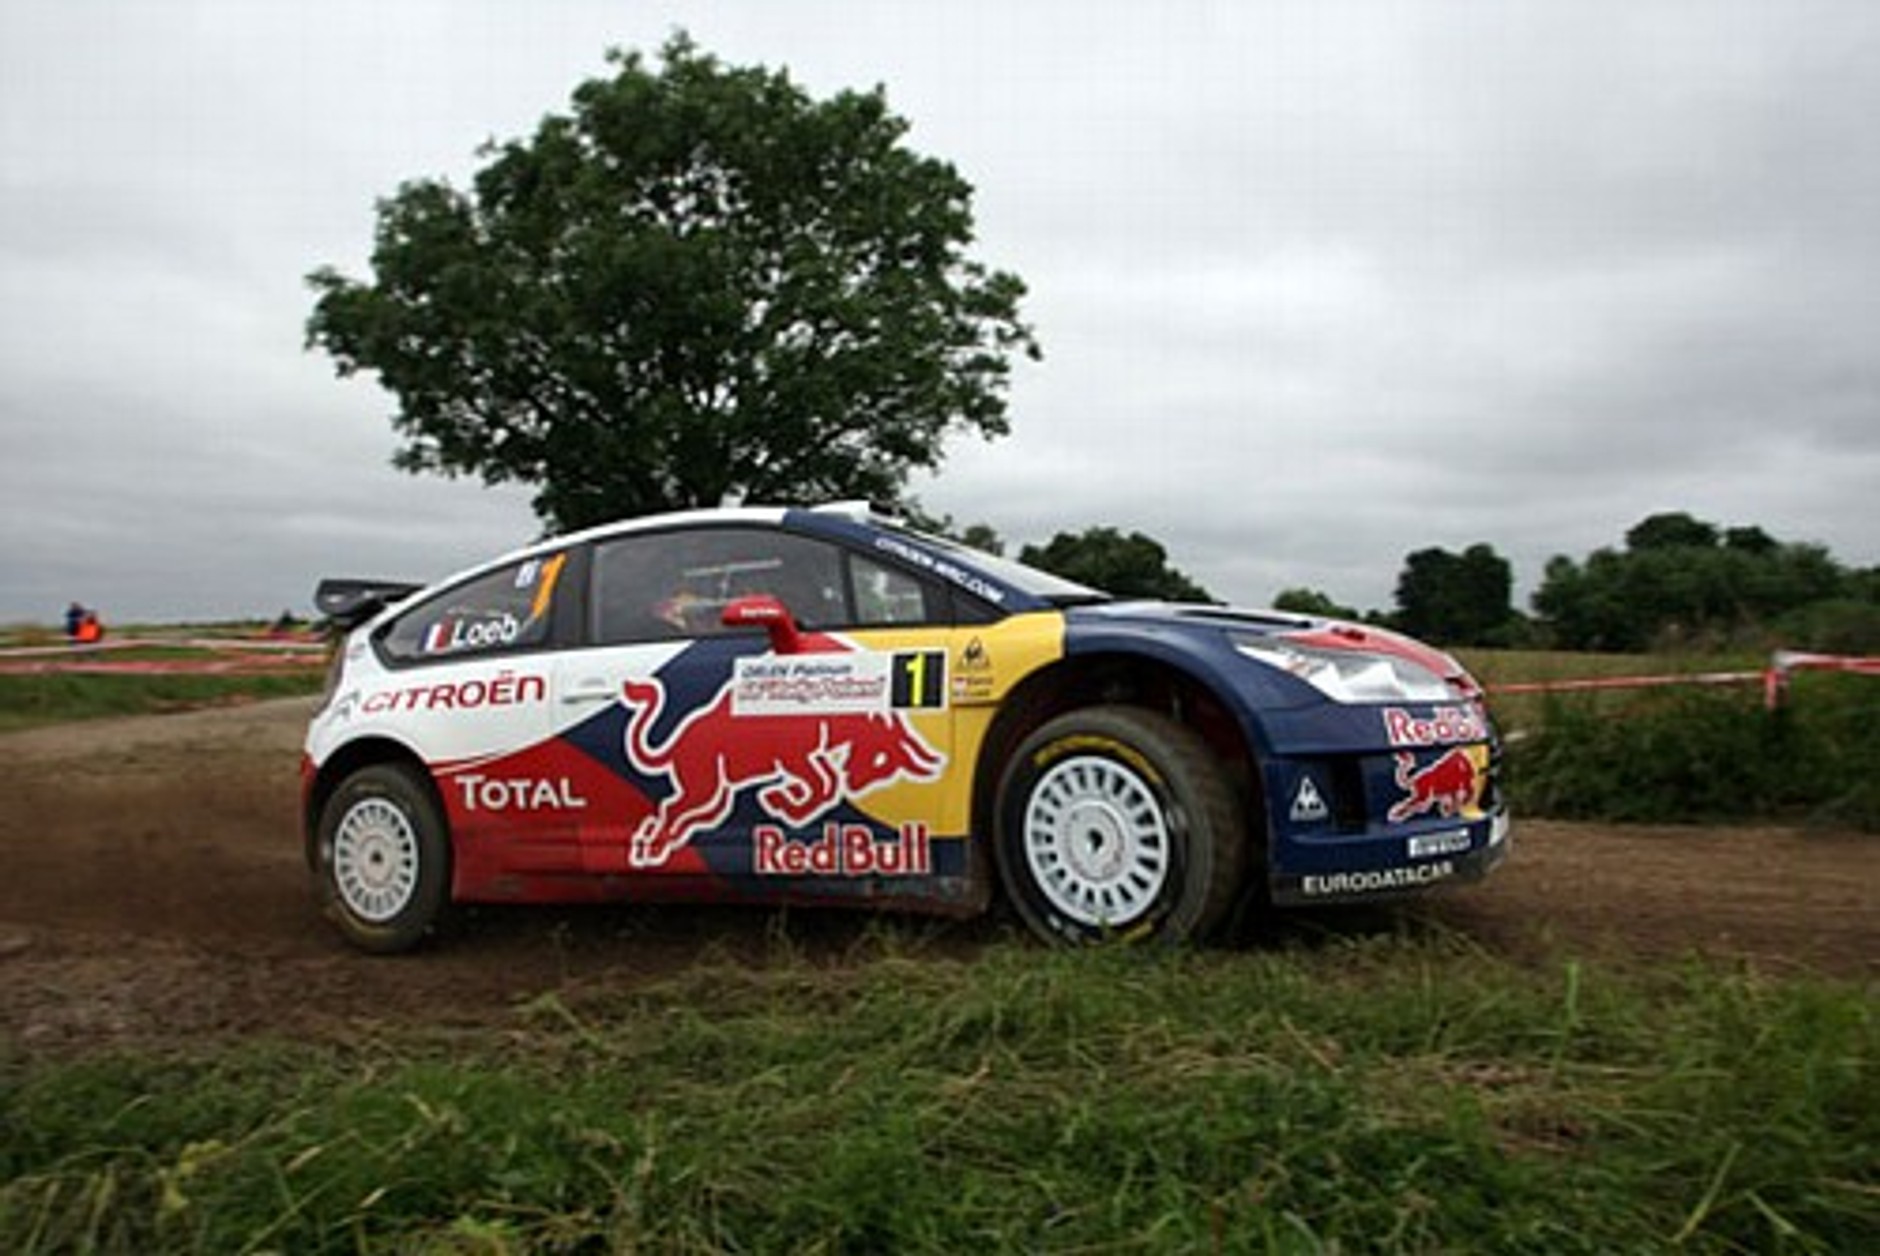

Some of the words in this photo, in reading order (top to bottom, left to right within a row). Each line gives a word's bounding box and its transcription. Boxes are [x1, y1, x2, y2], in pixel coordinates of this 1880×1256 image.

[532, 552, 566, 619] 1
[450, 613, 518, 647] Loeb
[905, 651, 926, 706] 1
[454, 774, 587, 809] TOTAL
[754, 822, 840, 874] Red
[840, 822, 931, 874] Bull
